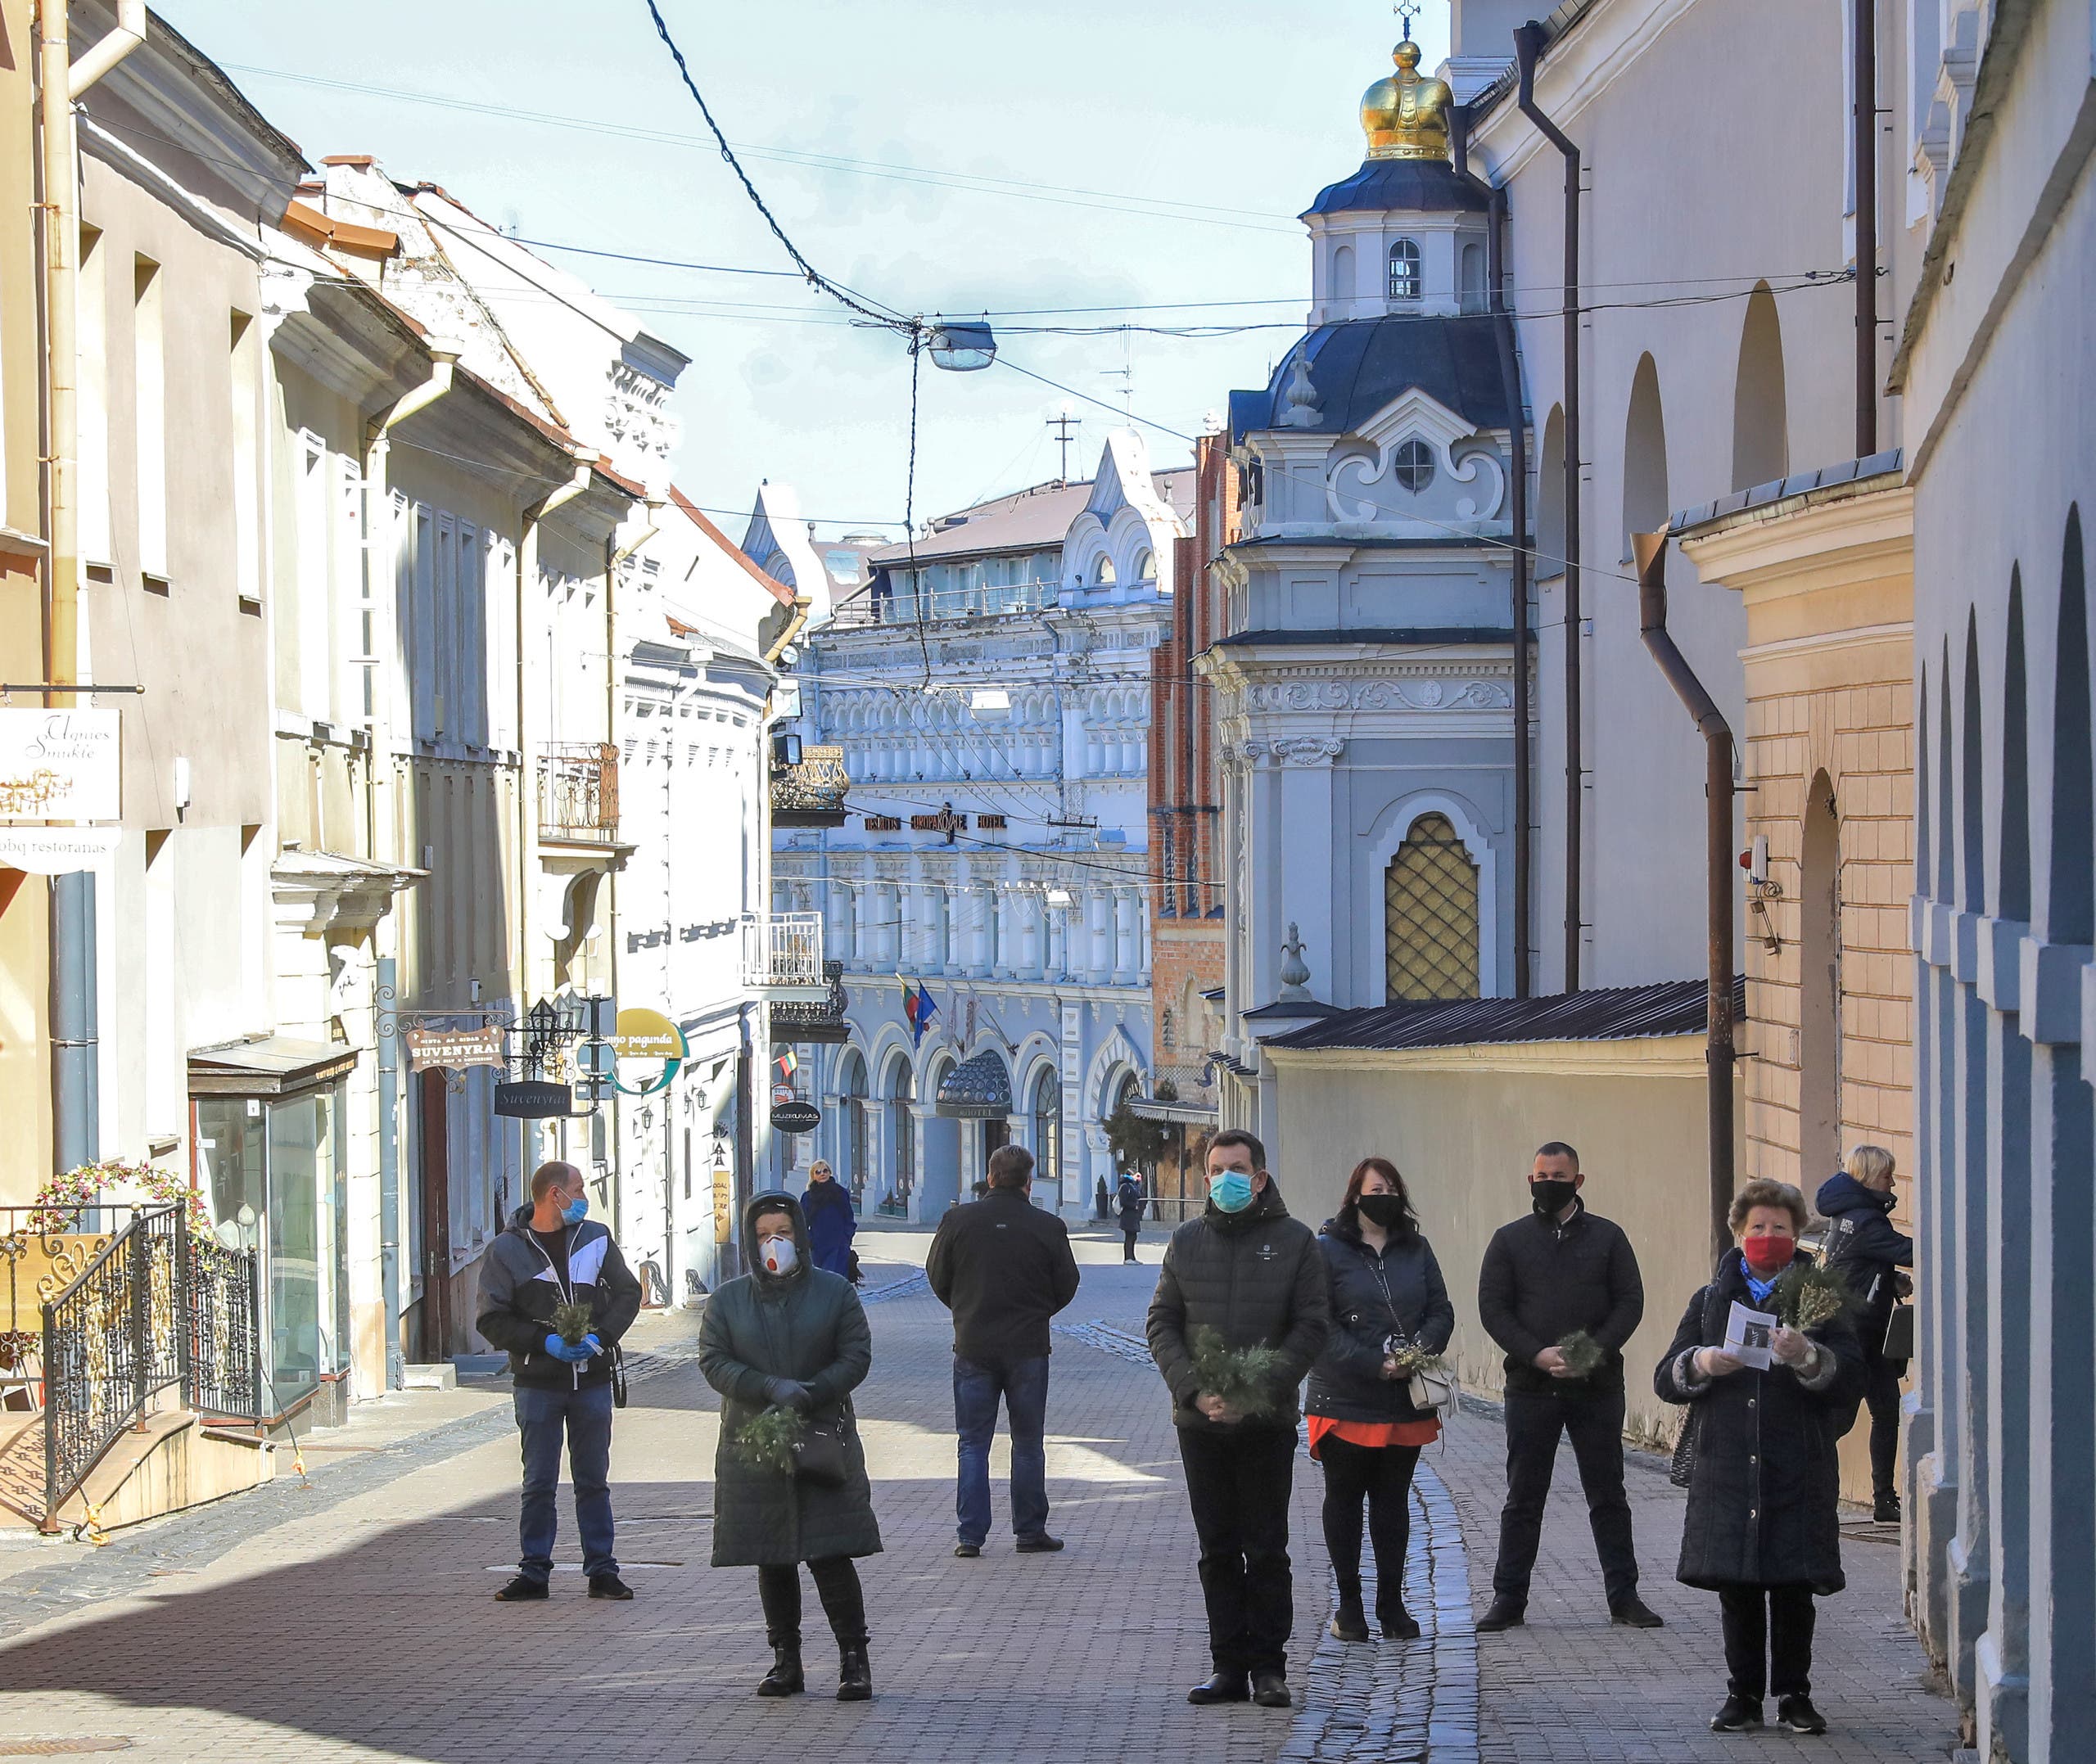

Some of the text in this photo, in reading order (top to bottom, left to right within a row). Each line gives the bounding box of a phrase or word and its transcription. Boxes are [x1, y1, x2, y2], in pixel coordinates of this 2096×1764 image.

[978, 815, 1005, 828] HOTEL
[32, 841, 106, 854] restoranas
[628, 1033, 672, 1048] pagunda
[412, 1043, 500, 1058] SUVENYRAI
[500, 1093, 565, 1105] Suvenyrai
